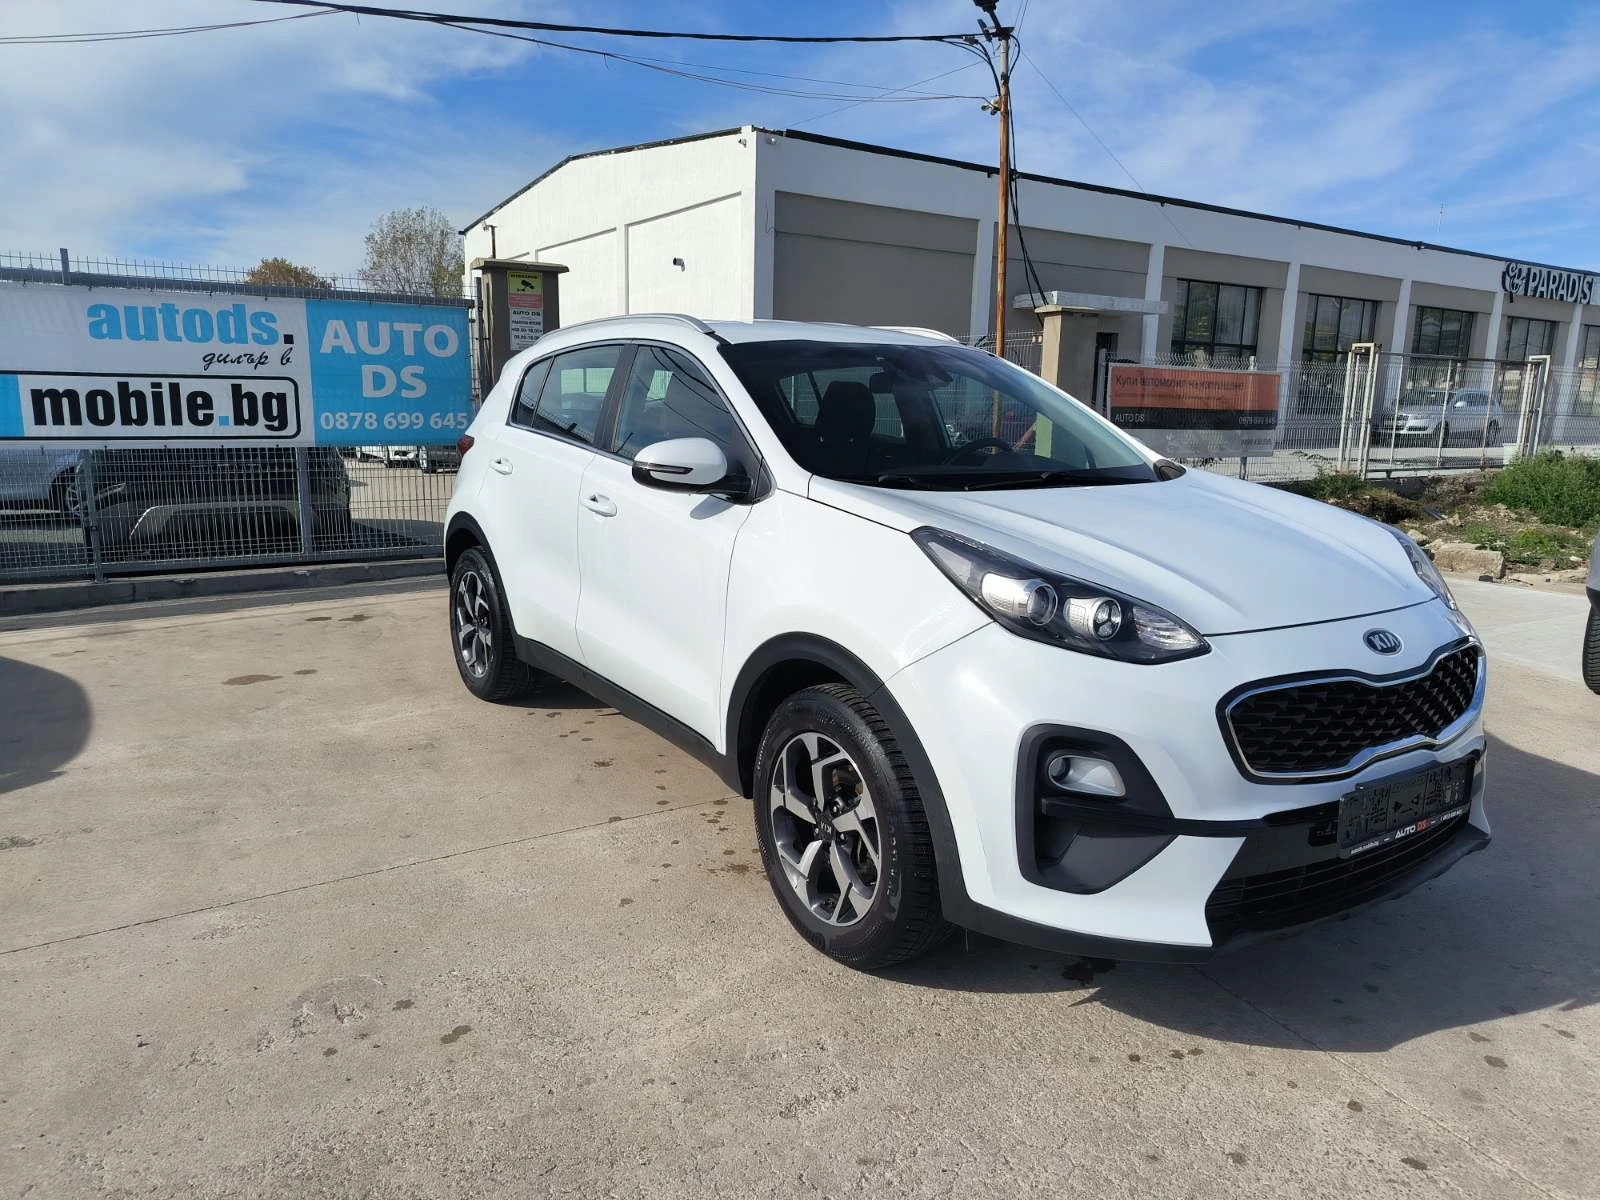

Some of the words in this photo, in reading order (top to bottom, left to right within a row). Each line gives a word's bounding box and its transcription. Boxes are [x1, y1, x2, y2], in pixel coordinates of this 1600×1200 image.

[319, 319, 459, 358] AUTO
[202, 351, 269, 371] дилър
[361, 364, 427, 399] DS
[30, 381, 289, 432] mobile.bg
[320, 411, 378, 430] 0878
[383, 411, 424, 430] 699
[430, 411, 468, 430] 645
[1369, 632, 1400, 650] KIA
[1395, 825, 1416, 839] AUTO
